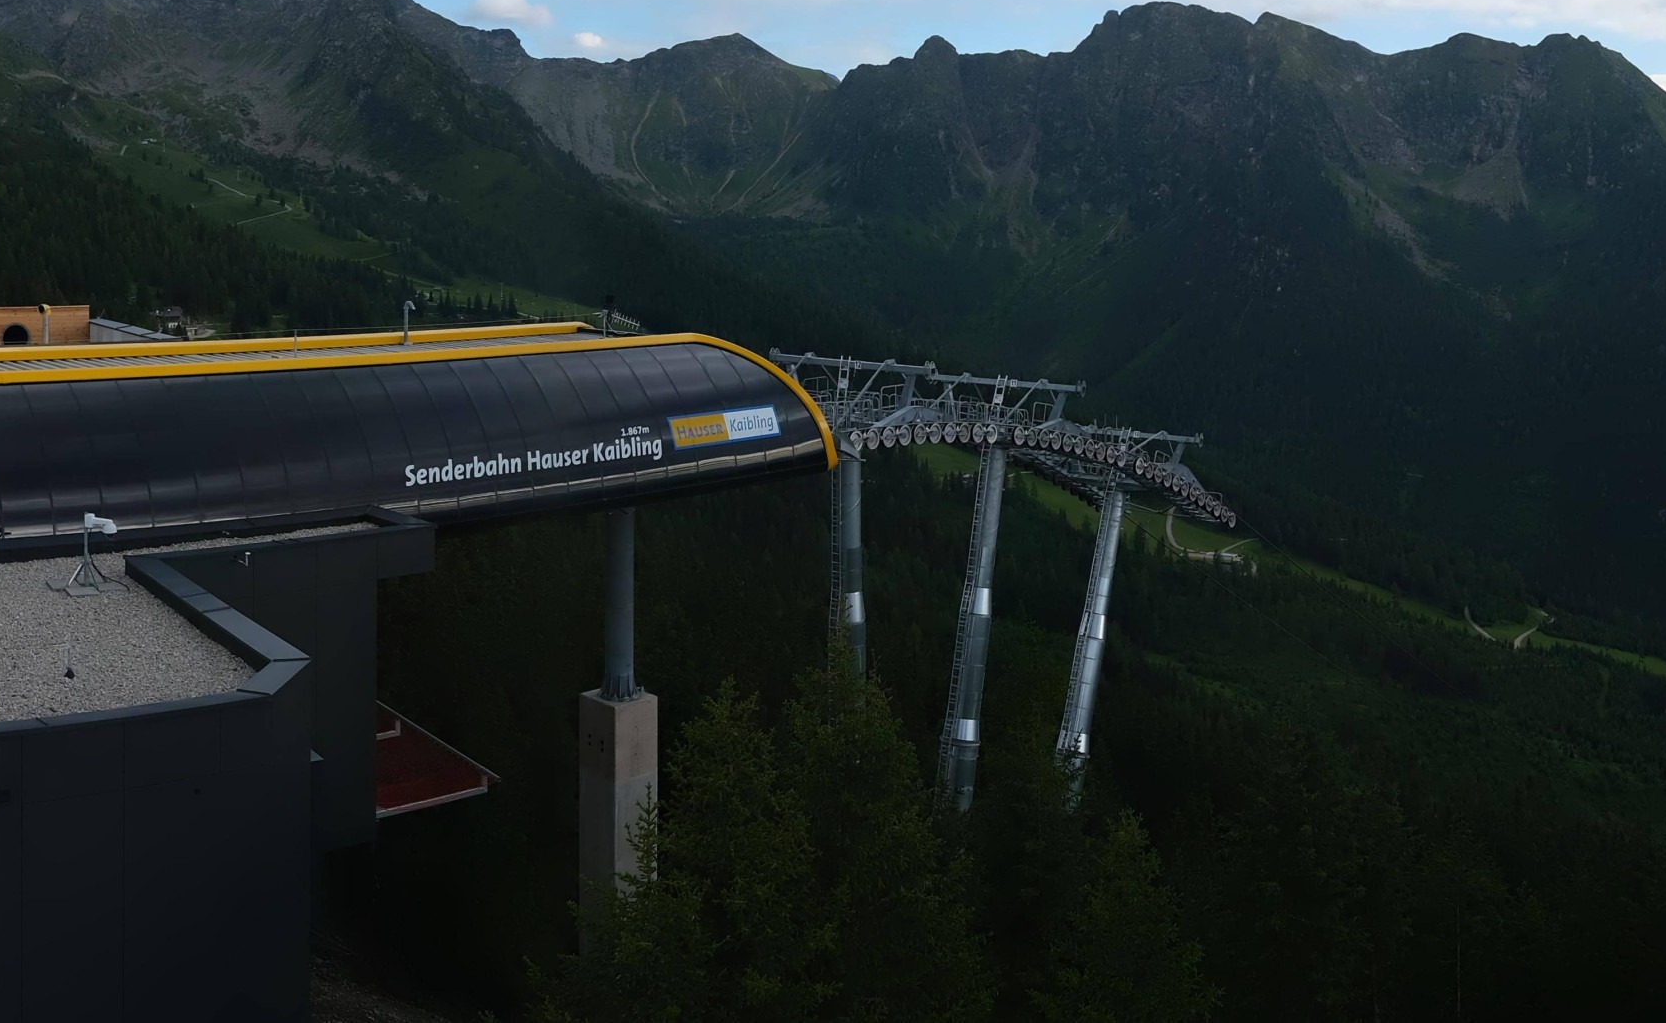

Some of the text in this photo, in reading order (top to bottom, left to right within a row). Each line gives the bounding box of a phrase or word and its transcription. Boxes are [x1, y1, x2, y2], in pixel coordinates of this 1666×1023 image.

[621, 426, 650, 437] 1.867m
[676, 415, 774, 440] HAUSER Kaibling
[405, 436, 663, 487] Senderbahn Hauser Kaibling
